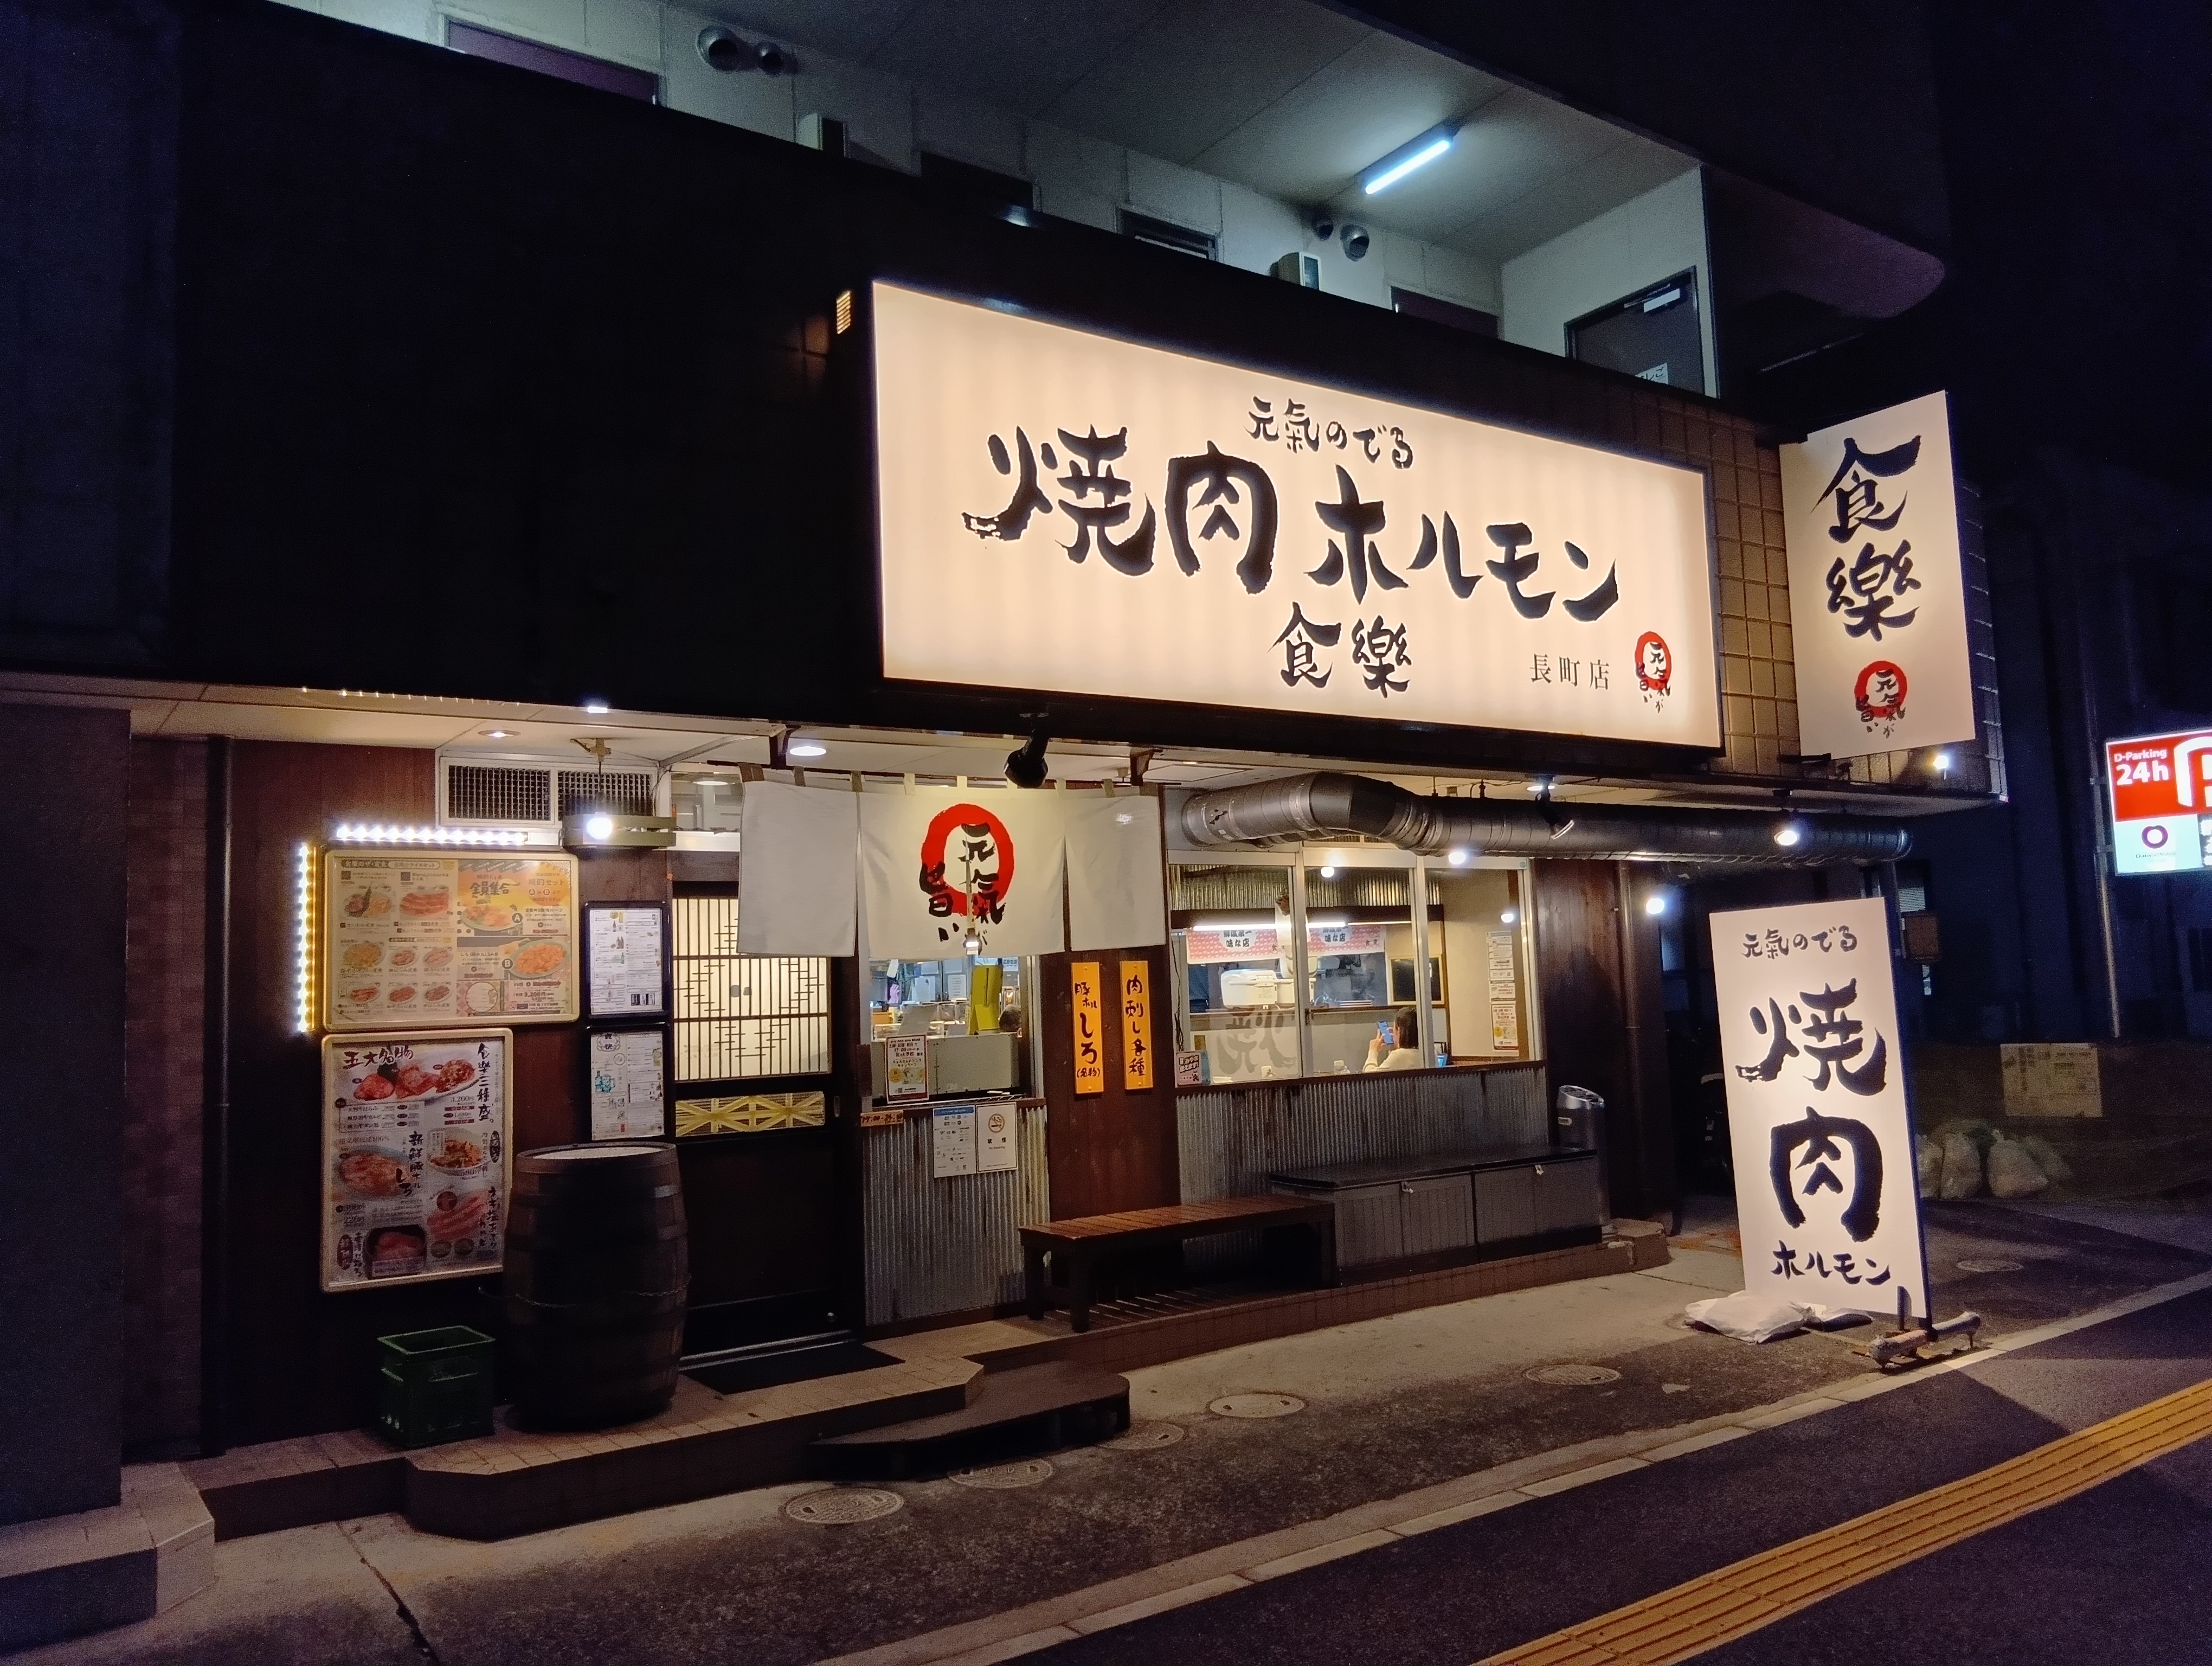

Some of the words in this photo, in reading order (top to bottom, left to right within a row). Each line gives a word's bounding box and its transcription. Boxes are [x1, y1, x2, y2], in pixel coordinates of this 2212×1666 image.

[1246, 395, 1413, 470] 元氣のでる
[1811, 434, 1921, 641] 食樂
[1271, 602, 1412, 699] 食樂
[1529, 653, 1610, 690] 長町店
[2114, 749, 2167, 762] D-Parking
[2116, 760, 2169, 786] 24h
[1226, 938, 1250, 948] 味な店
[1324, 933, 1346, 943] 味な店
[1742, 924, 1858, 960] 元氣のでる
[1079, 1013, 1098, 1065] しろ
[1126, 975, 1147, 1077] 肉刺し各種
[342, 1043, 414, 1070] 五大名物
[1735, 978, 1888, 1242] 焼肉
[1771, 1240, 1891, 1286] ホルモン
